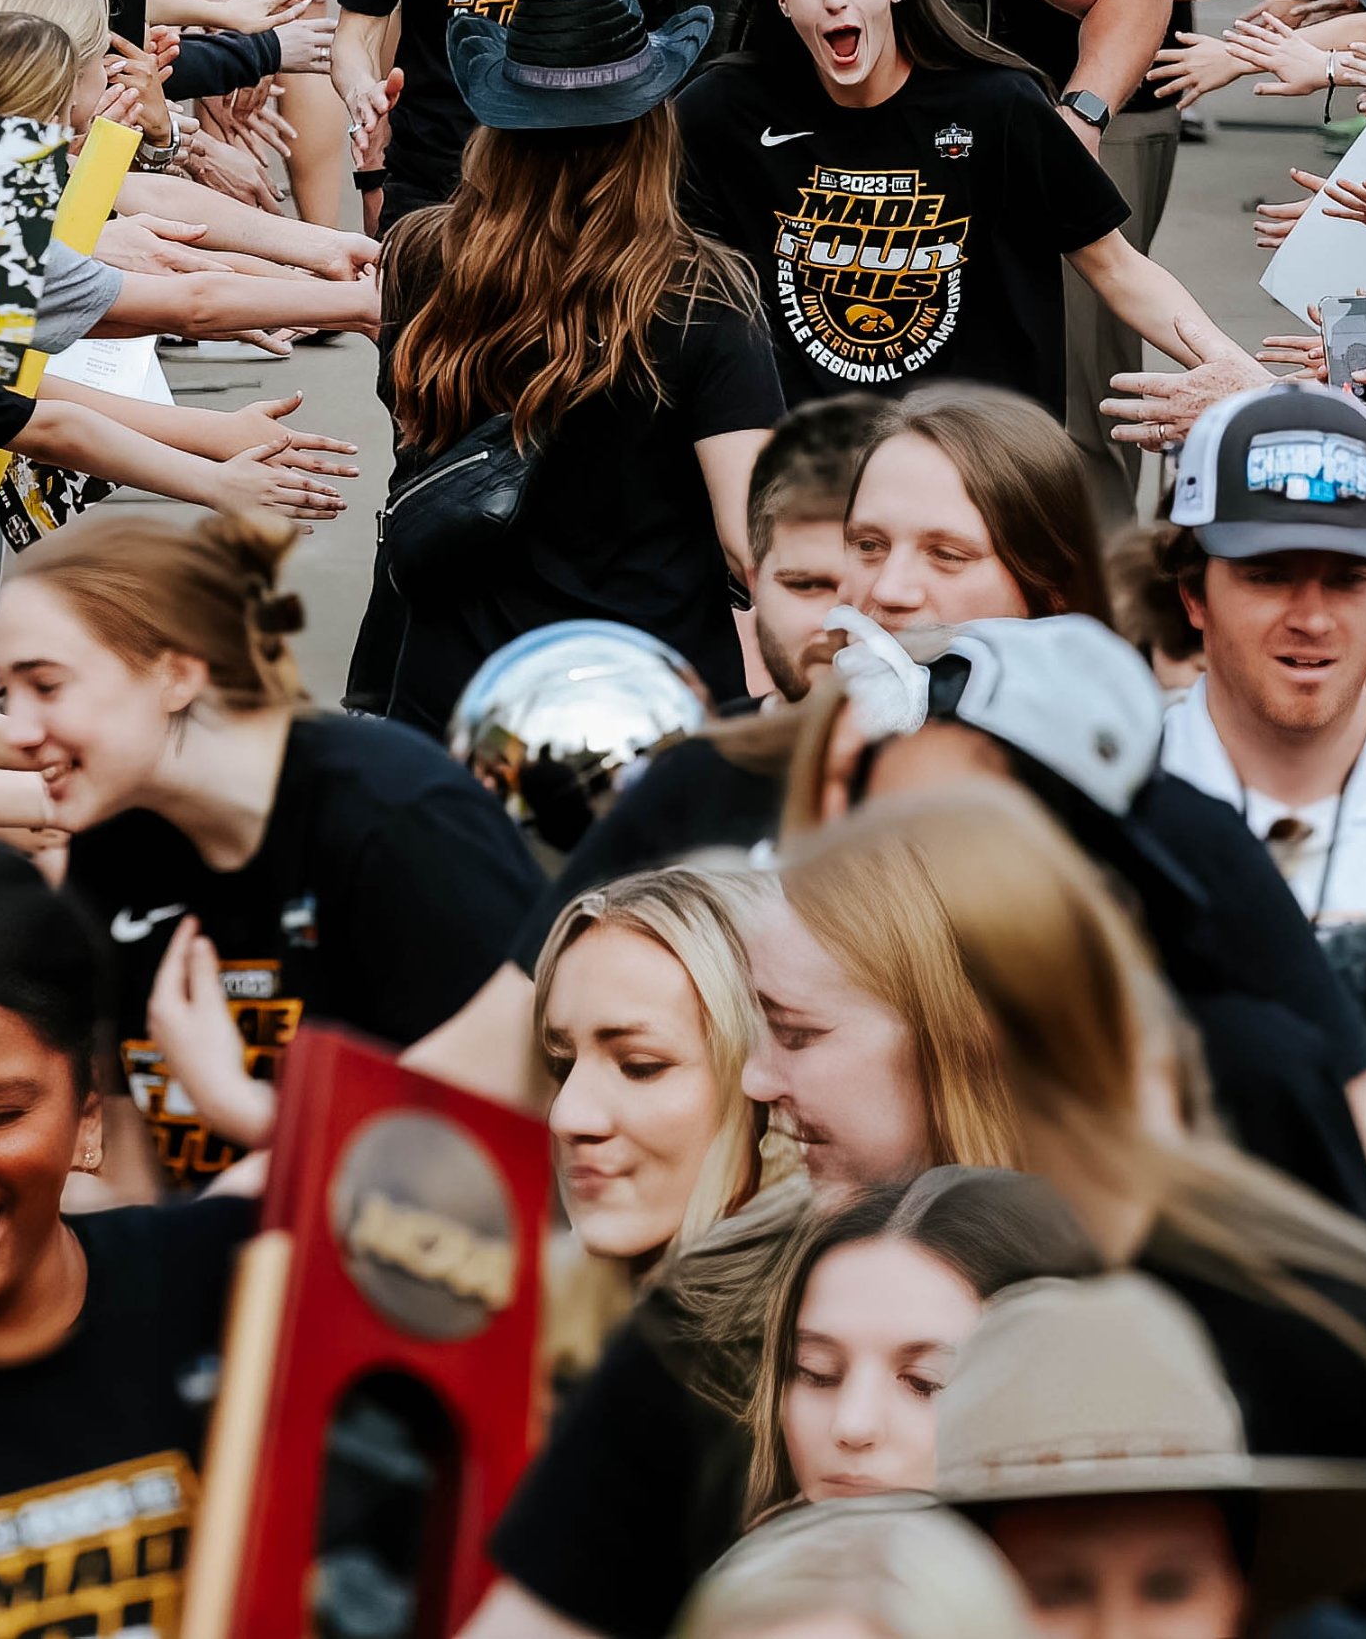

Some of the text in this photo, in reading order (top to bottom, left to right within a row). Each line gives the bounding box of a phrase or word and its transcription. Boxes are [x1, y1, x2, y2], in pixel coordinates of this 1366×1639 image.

[839, 175, 887, 193] 2023
[799, 194, 943, 228] MADE
[777, 219, 966, 271] FOUR
[798, 261, 941, 301] THIS
[778, 259, 962, 383] SEATTLE REGIONAL CHAMPIONS
[802, 295, 940, 362] UNIVERSITY OF IOWA
